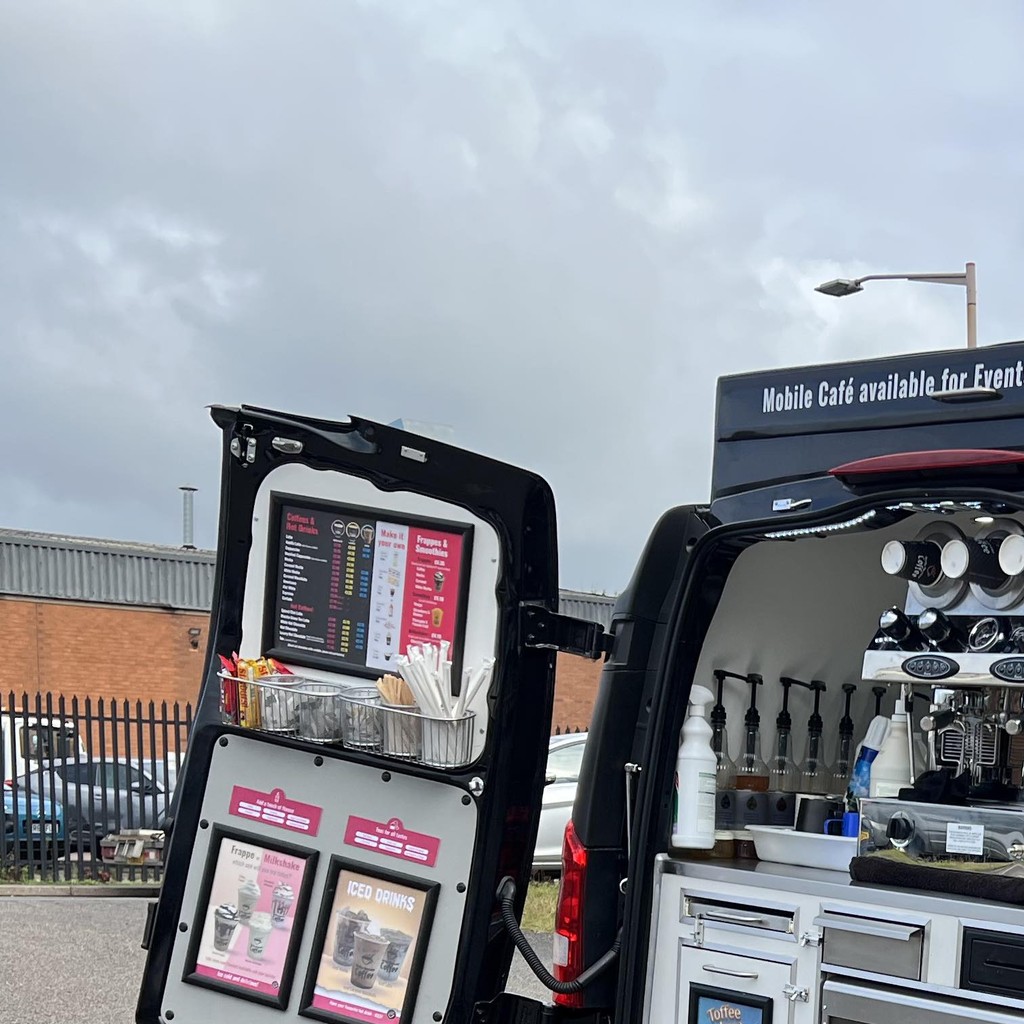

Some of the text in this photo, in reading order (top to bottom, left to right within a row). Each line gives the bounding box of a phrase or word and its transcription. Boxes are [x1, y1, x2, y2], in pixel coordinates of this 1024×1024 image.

[762, 383, 813, 413] Mobile
[818, 377, 854, 408] Café
[859, 369, 935, 402] available
[941, 368, 968, 391] for
[263, 854, 301, 872] Milkshake
[347, 880, 416, 913] ICED DRINKS
[707, 1004, 742, 1022] Toffee
